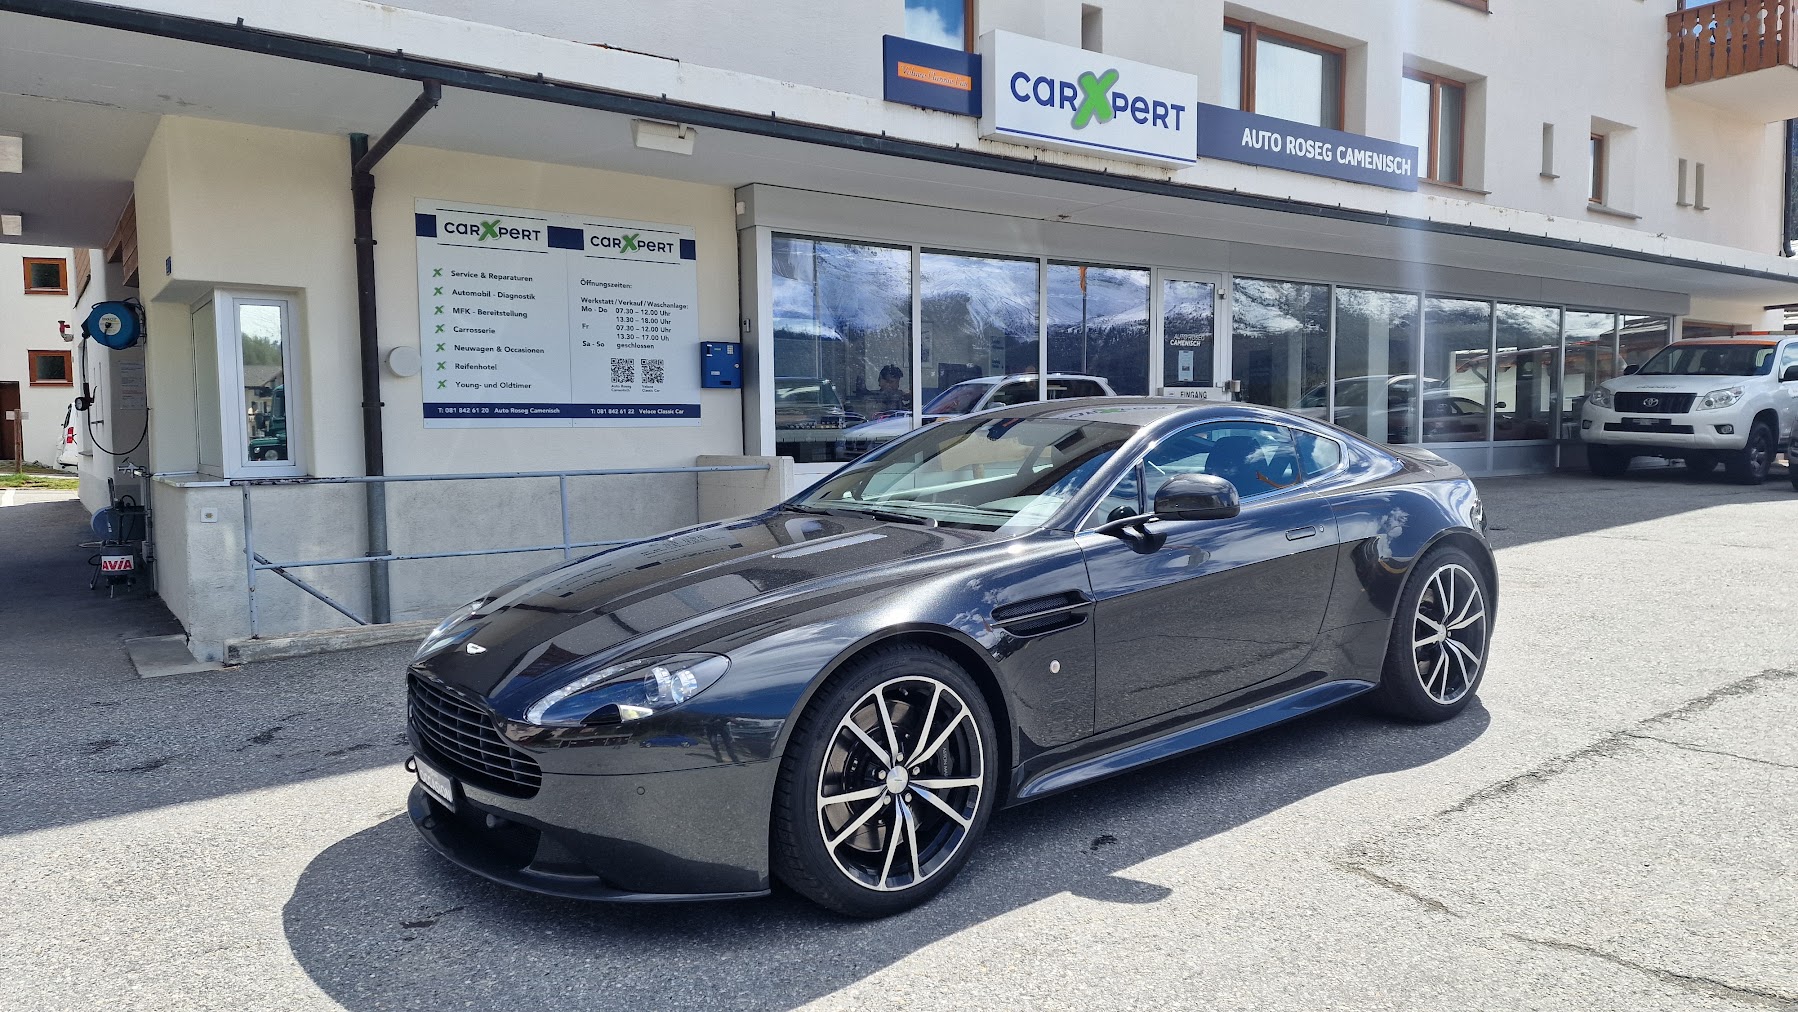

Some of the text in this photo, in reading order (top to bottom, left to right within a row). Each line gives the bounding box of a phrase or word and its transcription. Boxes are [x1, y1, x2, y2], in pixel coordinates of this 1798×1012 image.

[1242, 128, 1411, 176] AUTO ROSEG CAMENISCH
[451, 270, 478, 278] Service
[488, 273, 533, 282] Reparaturen
[580, 278, 632, 288] Öffnungszeiten:
[452, 289, 491, 297] Automobil
[497, 291, 536, 300] Diagnostik
[478, 309, 528, 319] Bereitstellung
[454, 345, 494, 353] Neuwagen
